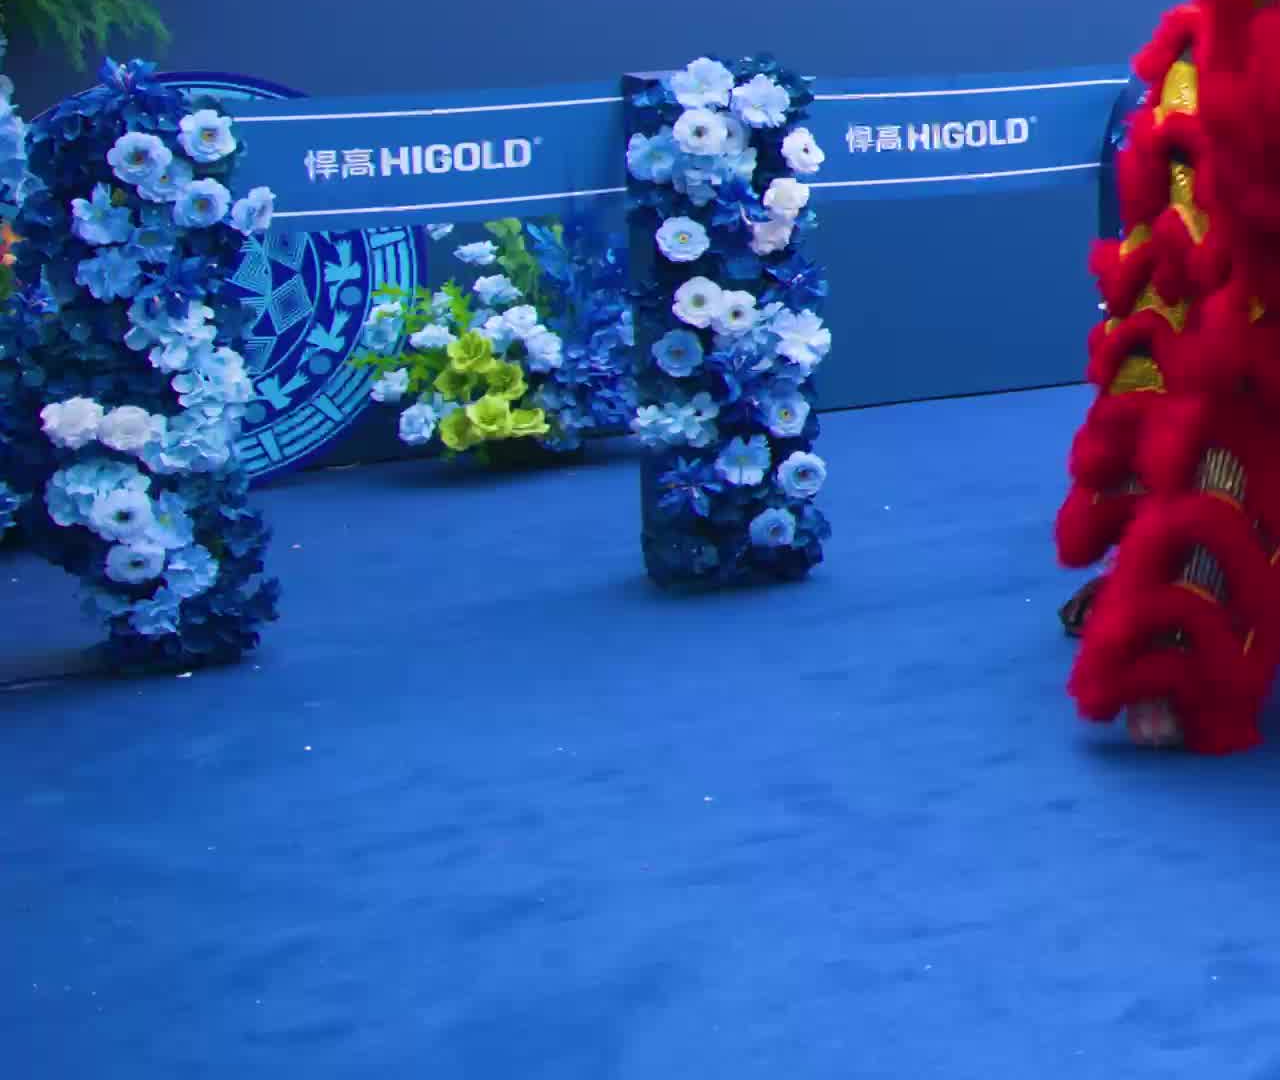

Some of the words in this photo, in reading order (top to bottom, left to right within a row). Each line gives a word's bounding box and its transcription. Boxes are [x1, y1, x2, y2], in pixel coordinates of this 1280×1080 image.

[907, 117, 1029, 151] HIGOLD
[304, 148, 375, 183] 悍高
[381, 138, 532, 177] HIGOLD
